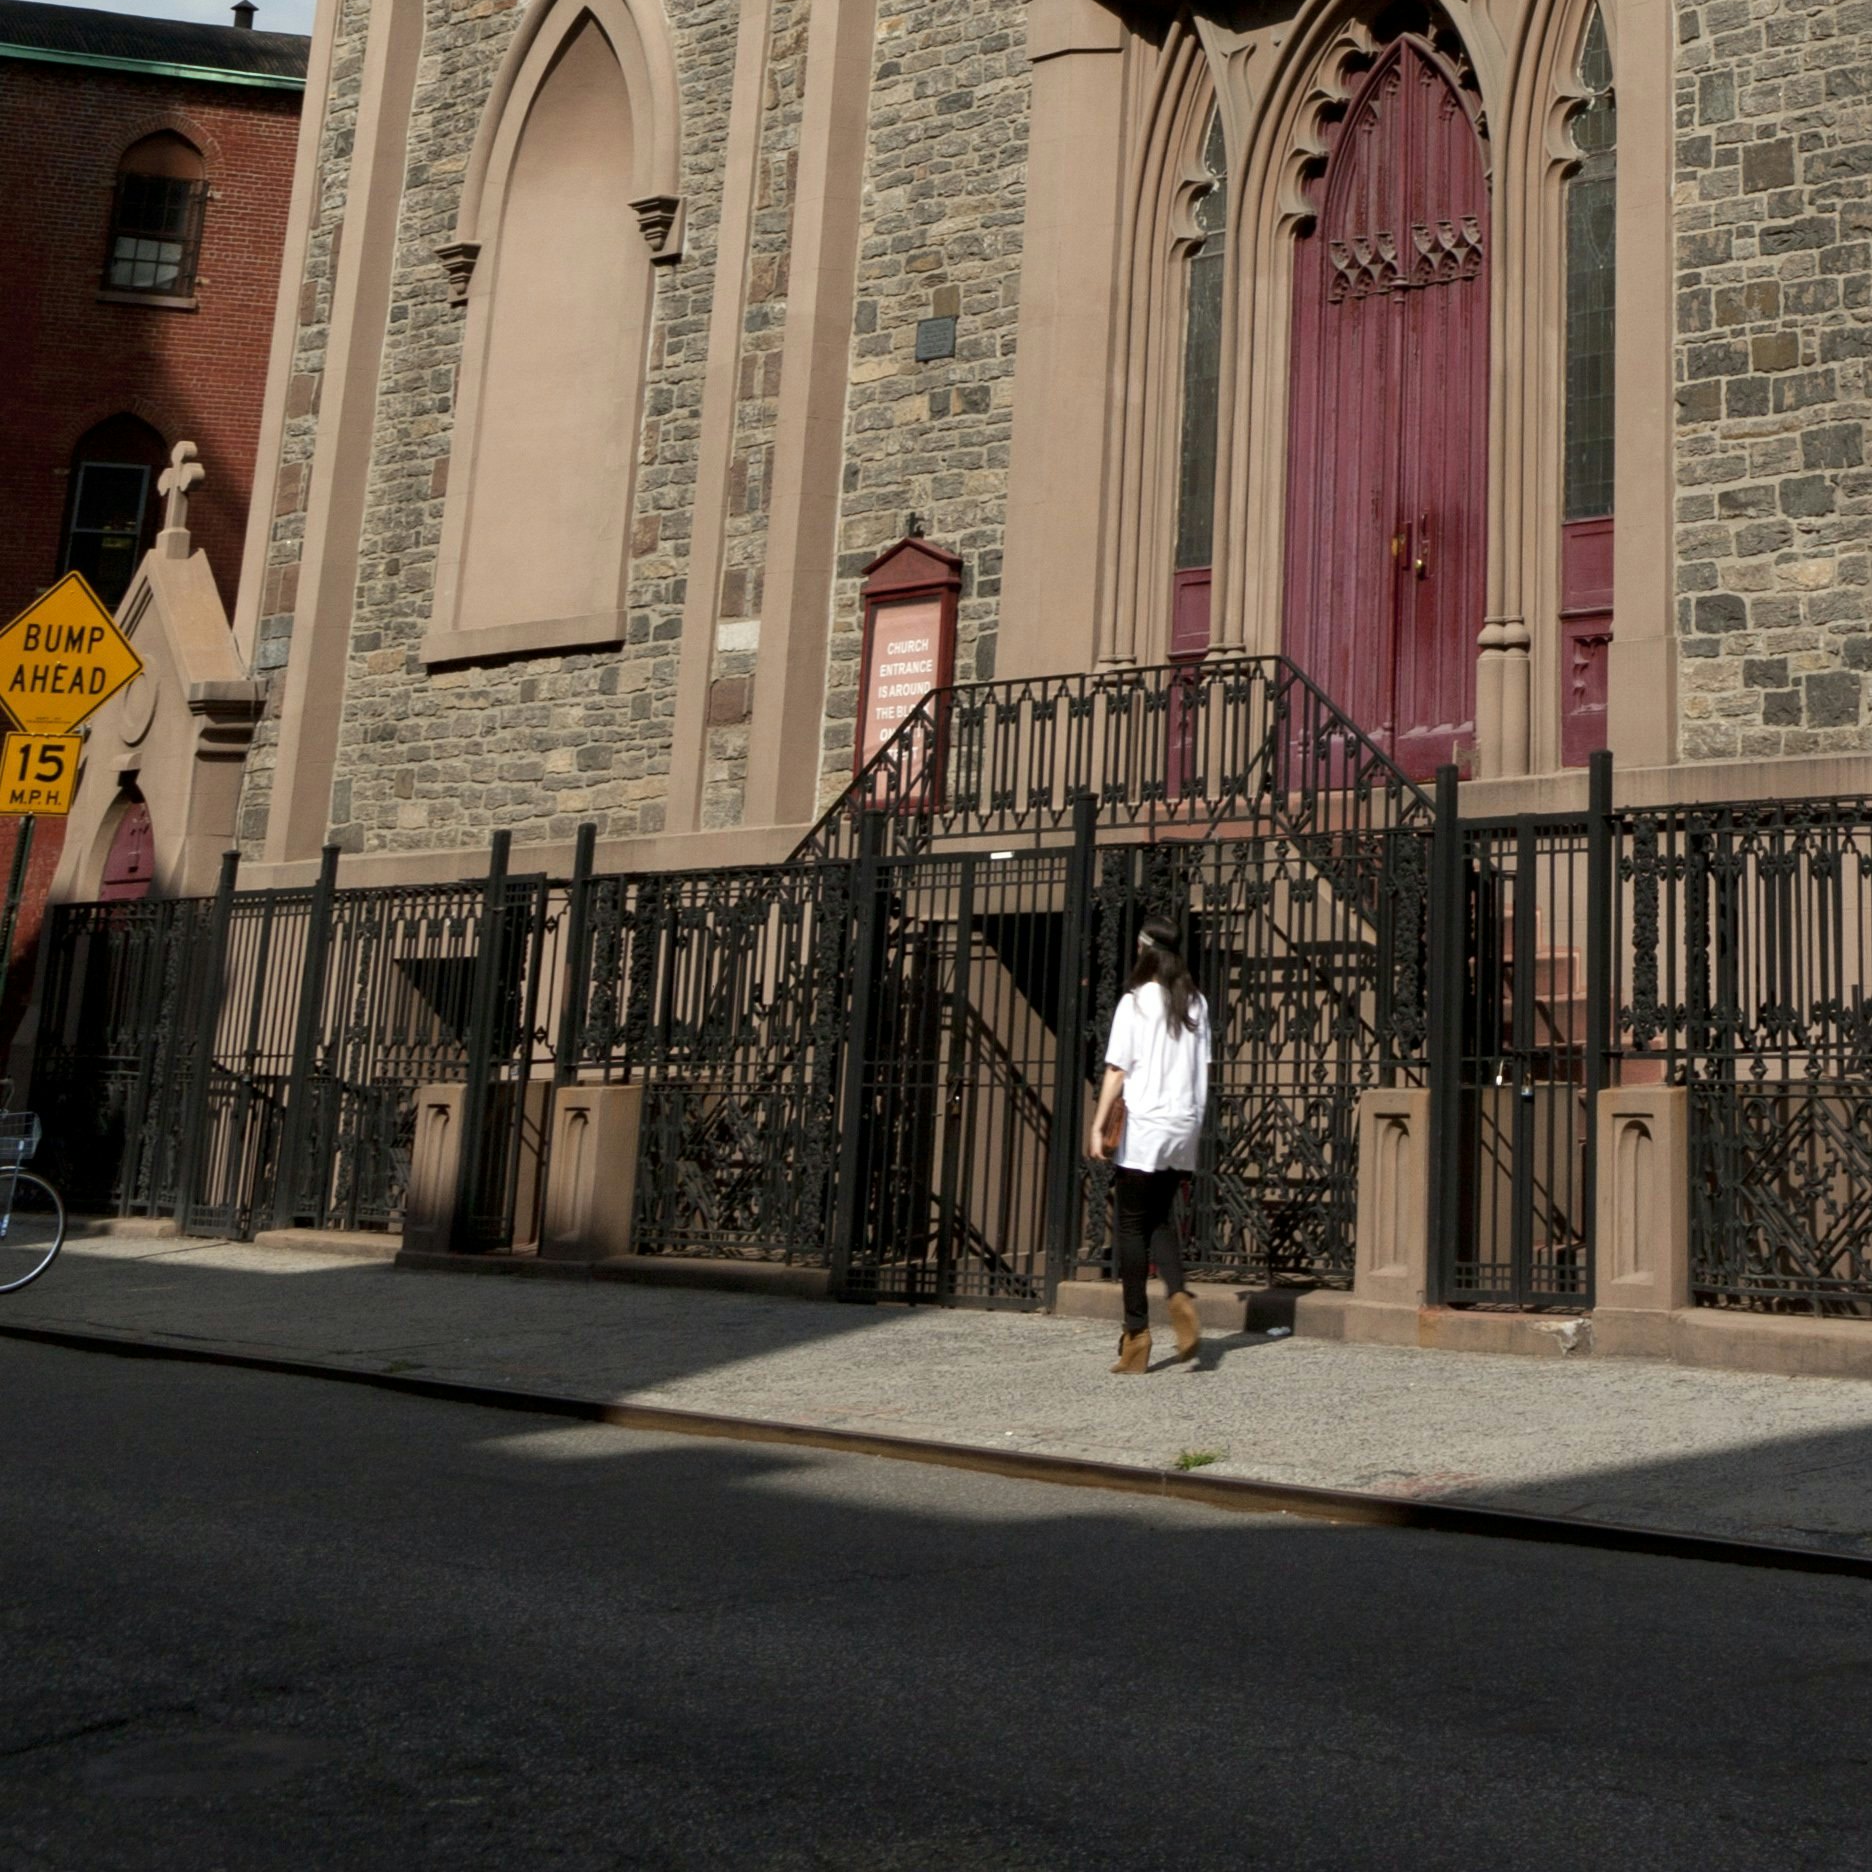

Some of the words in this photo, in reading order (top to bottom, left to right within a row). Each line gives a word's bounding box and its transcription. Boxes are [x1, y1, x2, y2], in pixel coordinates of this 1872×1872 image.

[23, 623, 105, 654] BUMP
[887, 638, 929, 656] CHURCH
[880, 659, 933, 677] ENTRANCE
[8, 663, 107, 696] AHEAD
[878, 686, 888, 698] IS
[888, 681, 931, 697] AROUND
[876, 706, 895, 720] THE
[18, 743, 66, 783] 15
[9, 788, 62, 805] M.P.H.
